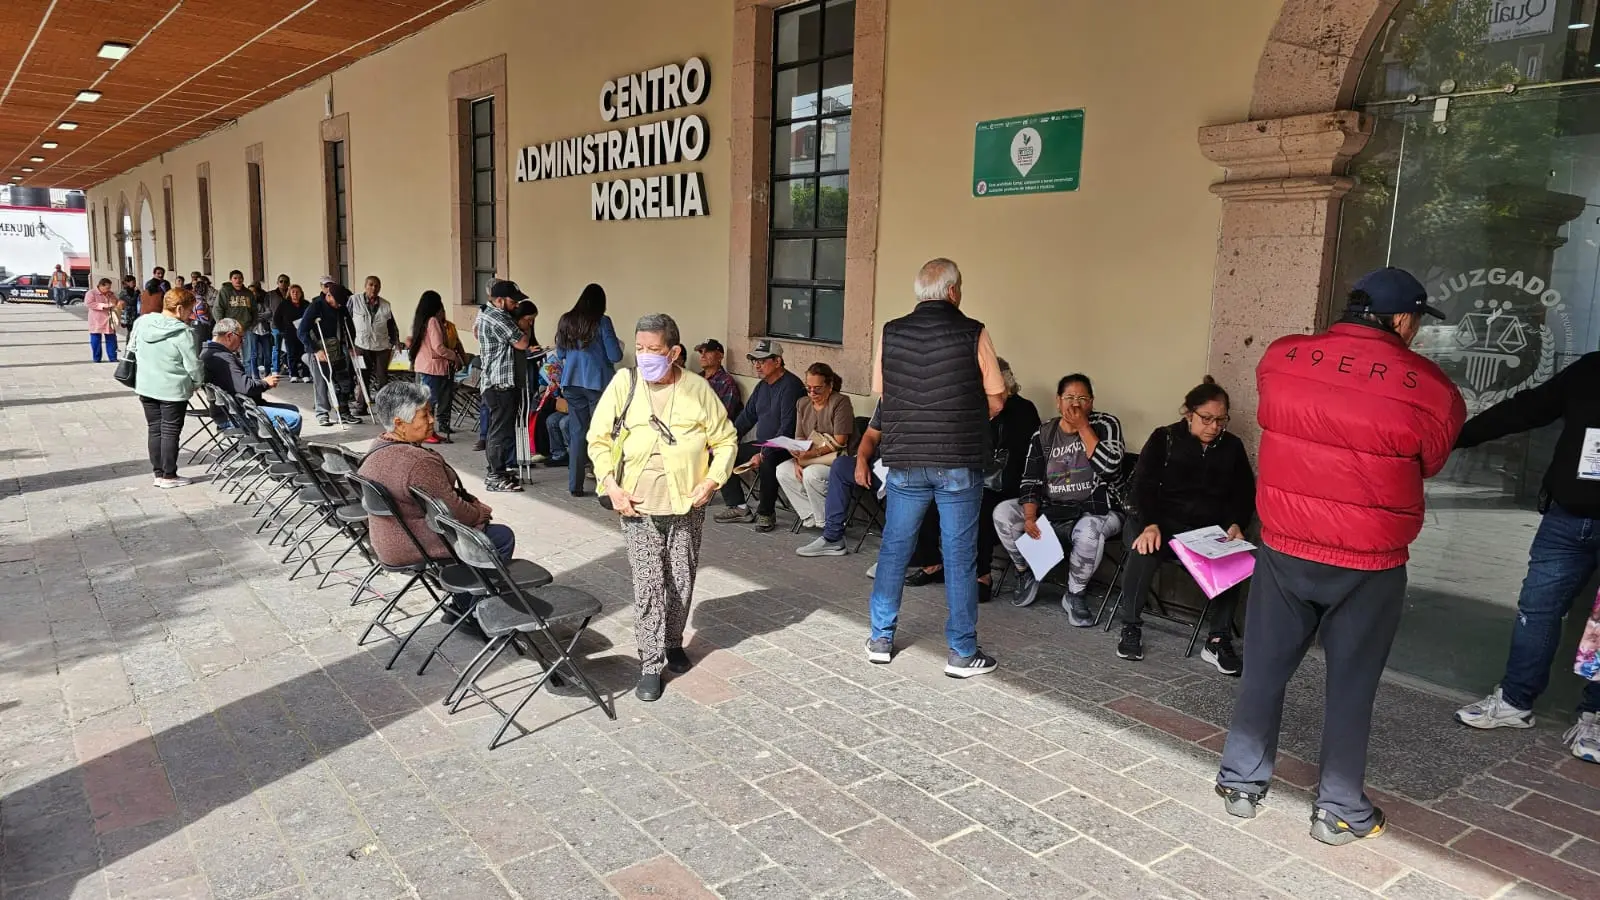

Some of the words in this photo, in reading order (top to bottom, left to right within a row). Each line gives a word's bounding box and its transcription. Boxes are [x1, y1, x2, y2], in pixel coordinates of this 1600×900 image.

[599, 56, 709, 122] CENTRO
[514, 114, 709, 183] ADMINISTRATIVO
[591, 172, 709, 221] MORELIA
[1438, 267, 1561, 307] JUZGADO
[1285, 346, 1418, 389] 49ERS
[1049, 481, 1092, 494] DEPARTURE
